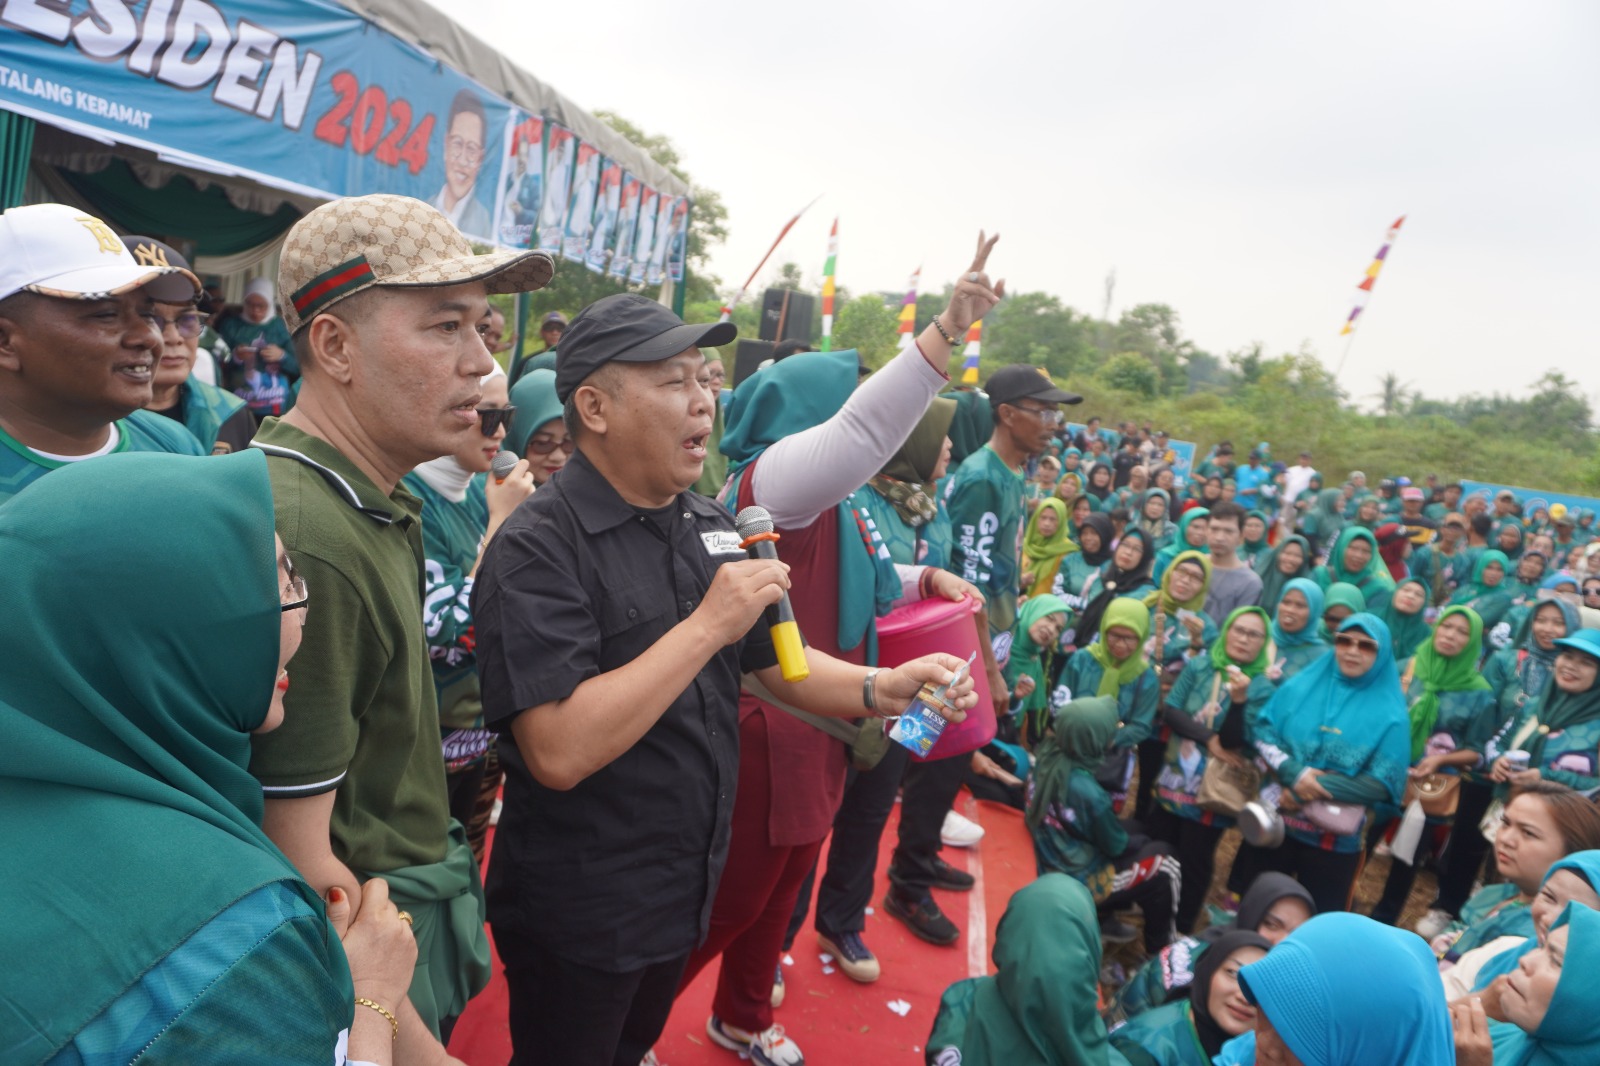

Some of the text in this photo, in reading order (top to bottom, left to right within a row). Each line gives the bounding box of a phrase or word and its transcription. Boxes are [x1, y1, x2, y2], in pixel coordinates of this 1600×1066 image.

[0, 66, 152, 129] TALANG KERAMAT
[314, 69, 436, 176] 2024
[929, 711, 947, 727] ESSE
